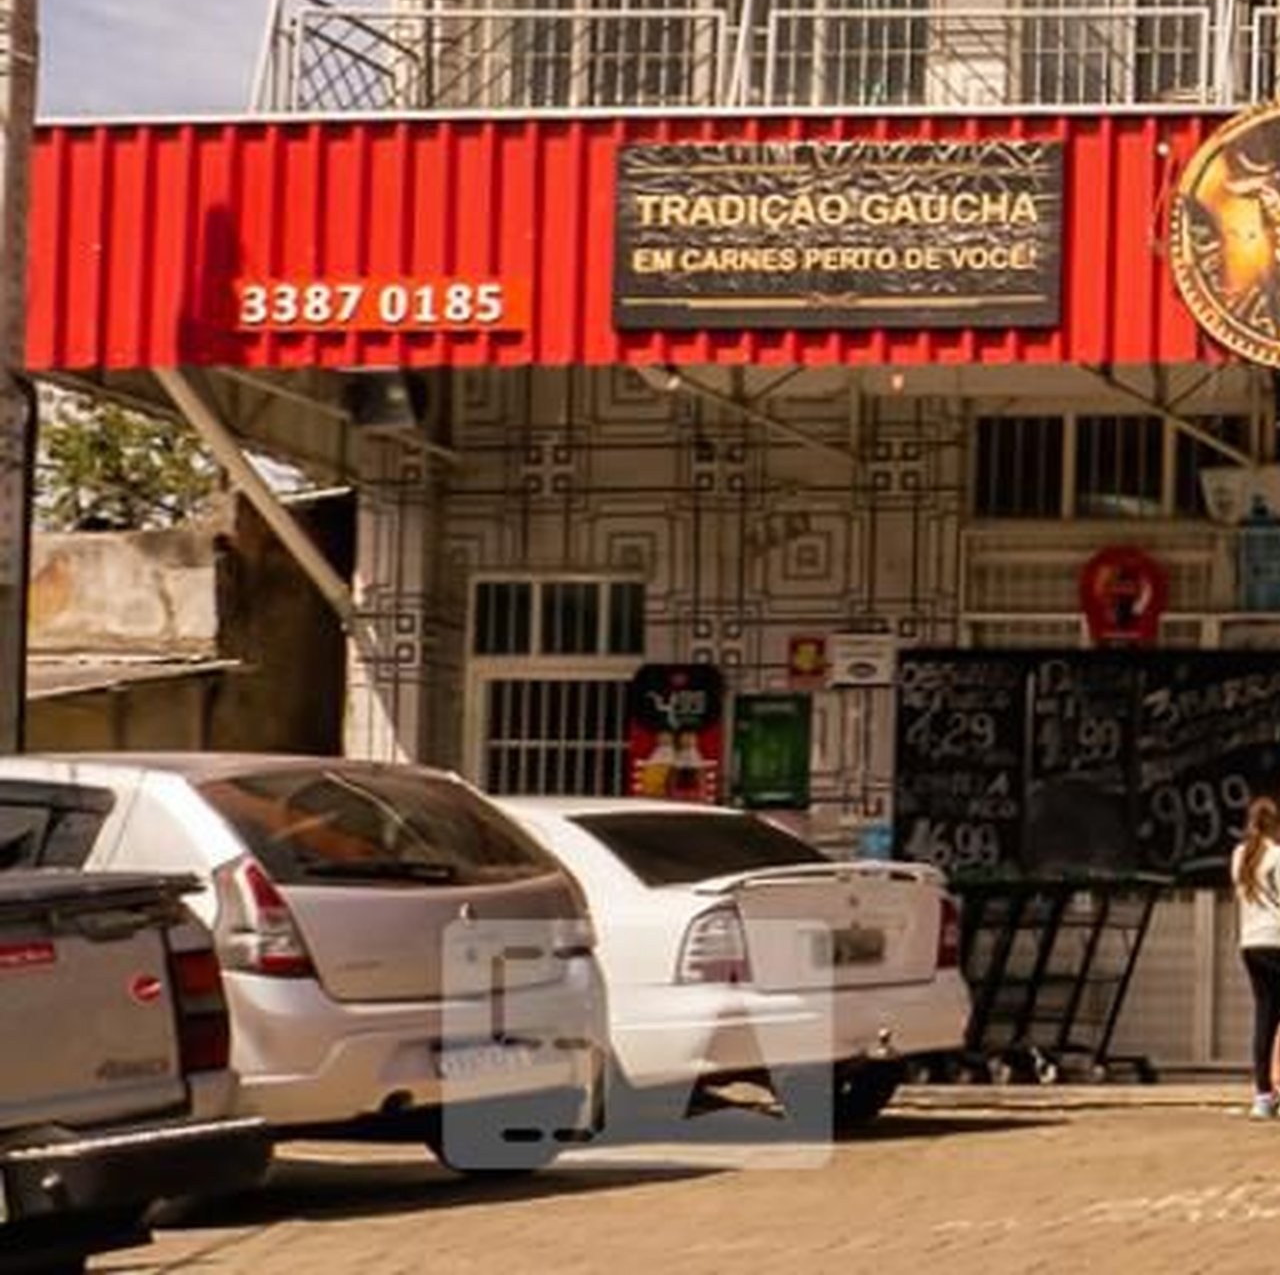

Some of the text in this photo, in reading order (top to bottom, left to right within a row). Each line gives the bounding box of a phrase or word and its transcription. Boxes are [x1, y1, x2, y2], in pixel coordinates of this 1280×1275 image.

[633, 249, 673, 273] EM
[680, 248, 797, 272] CARNES
[802, 246, 897, 271] PERTO
[904, 245, 942, 270] DE
[239, 283, 502, 324] 3387 0185
